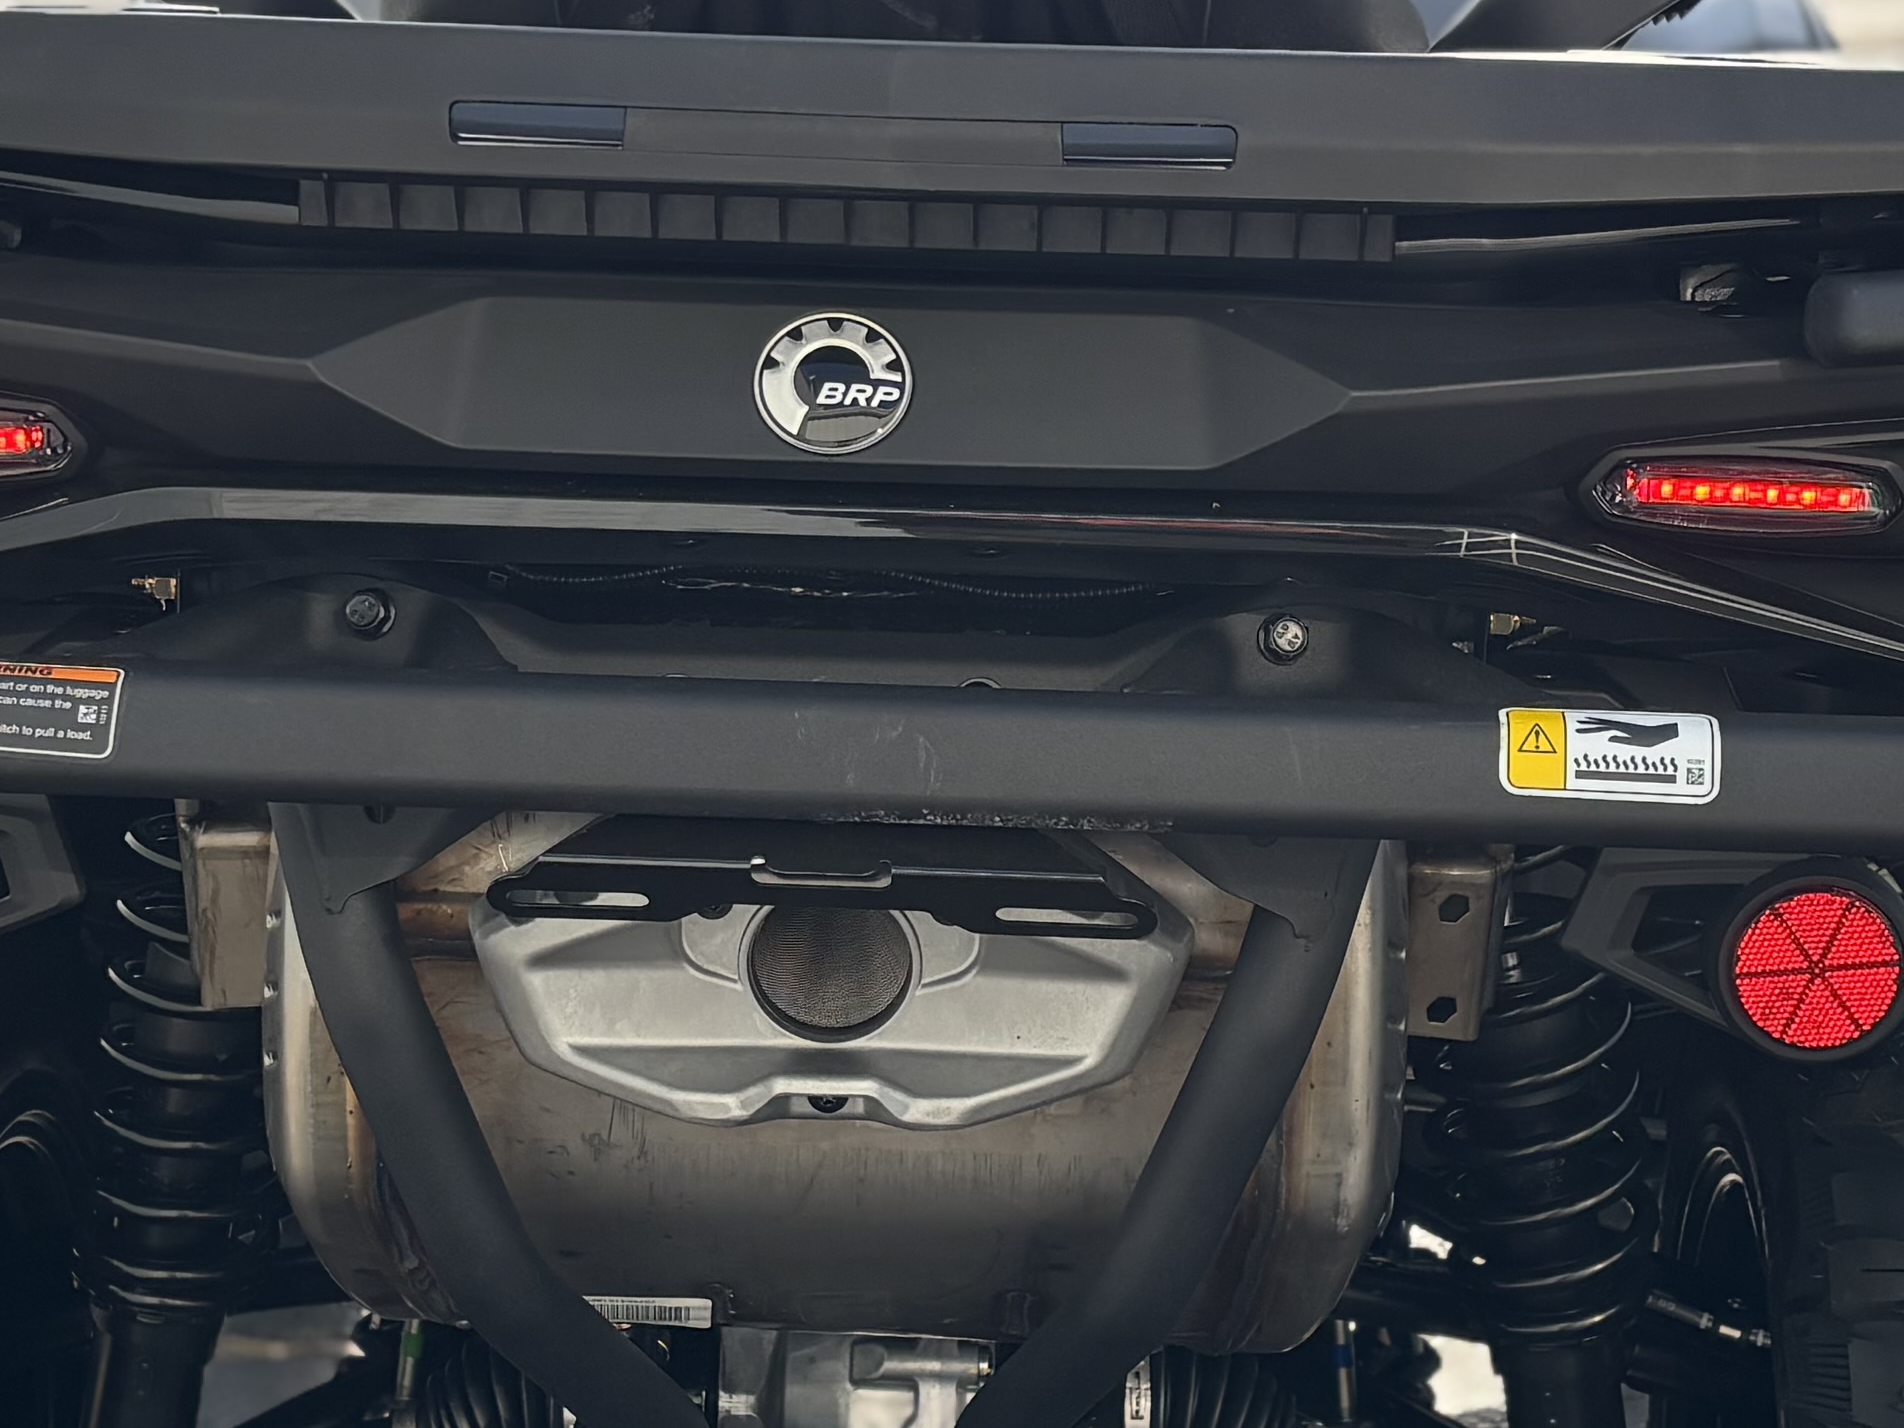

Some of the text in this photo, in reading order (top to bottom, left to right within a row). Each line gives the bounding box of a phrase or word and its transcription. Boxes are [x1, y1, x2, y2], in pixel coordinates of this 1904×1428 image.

[816, 382, 902, 408] BRP
[15, 683, 27, 692] or
[29, 684, 44, 693] on
[46, 684, 64, 695] the
[65, 686, 109, 700] luggage
[19, 697, 53, 708] cause
[54, 699, 73, 710] the
[22, 726, 33, 736] to
[34, 727, 55, 738] pull
[56, 730, 65, 739] a
[66, 729, 93, 741] load.
